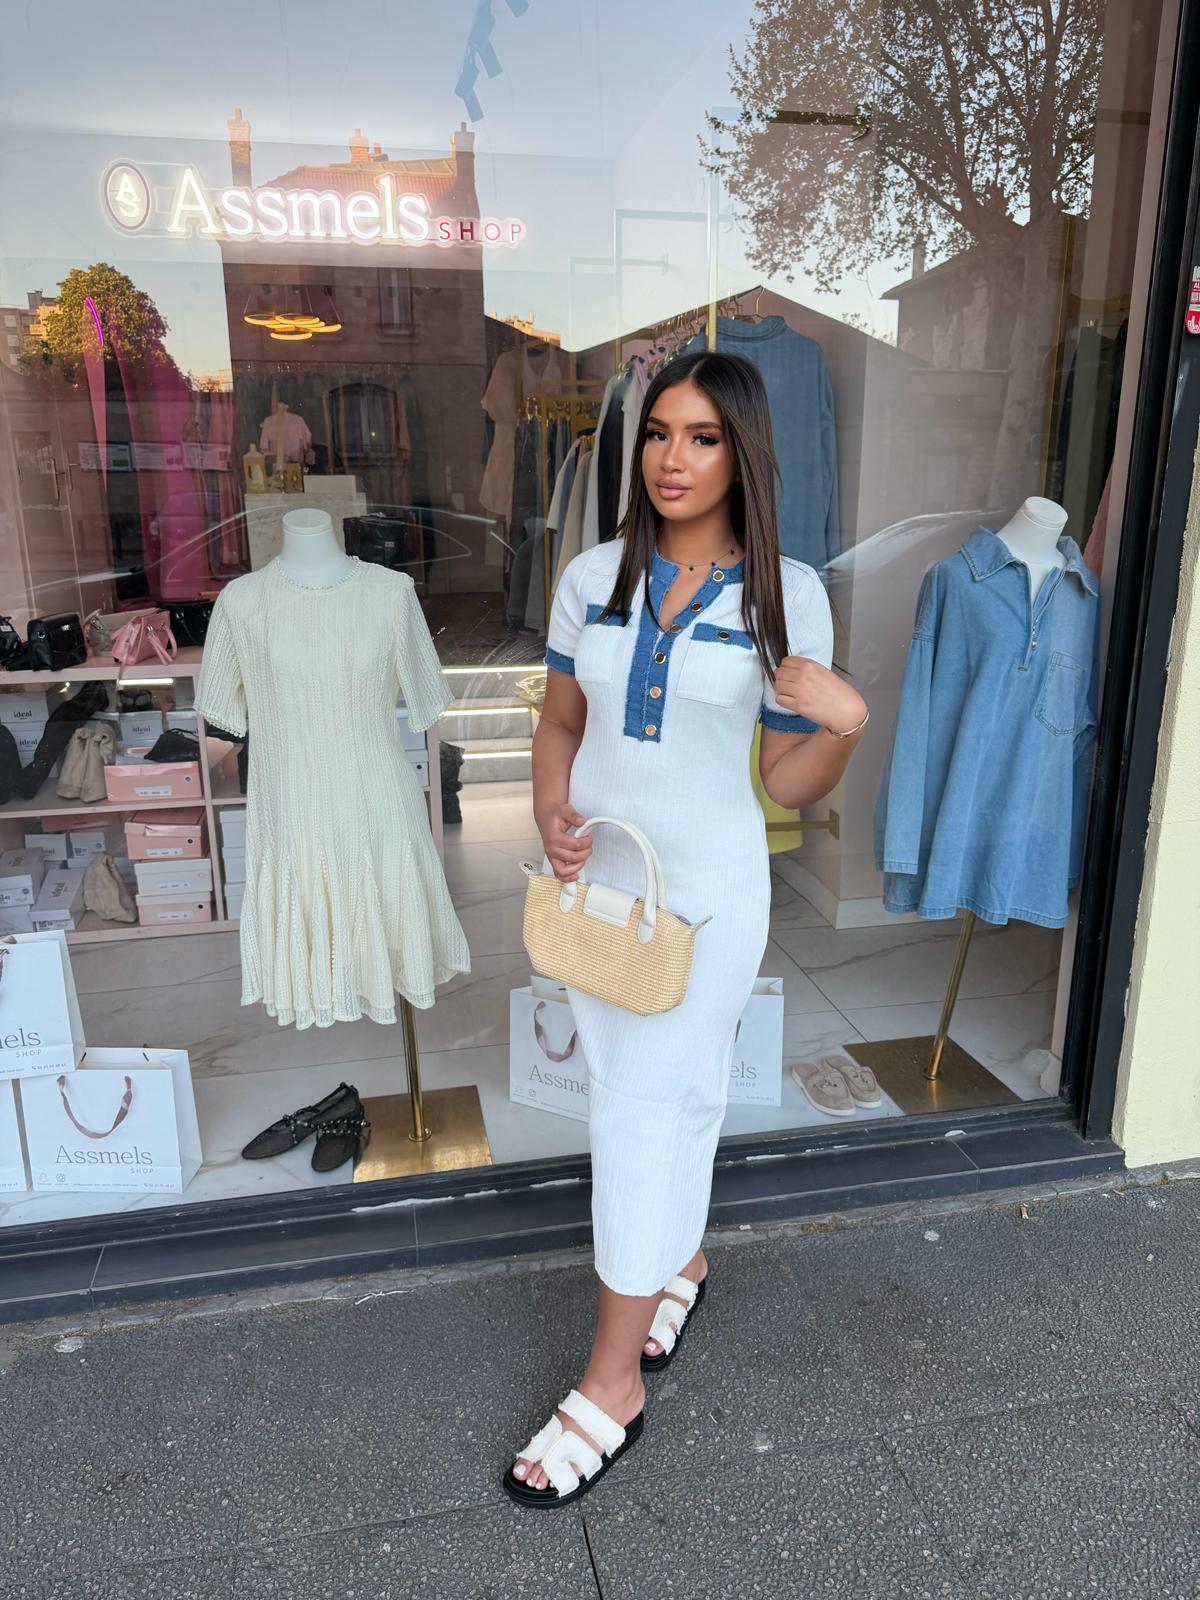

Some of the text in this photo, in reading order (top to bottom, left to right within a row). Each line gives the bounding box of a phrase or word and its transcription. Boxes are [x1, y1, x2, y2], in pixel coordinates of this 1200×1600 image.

[167, 167, 523, 242] Assmels SHOP
[0, 1027, 41, 1049] els
[15, 1049, 42, 1058] SHOP
[528, 1064, 589, 1096] Assme
[729, 1060, 757, 1080] els
[55, 1144, 153, 1166] Assmels
[130, 1167, 154, 1175] SHOP
